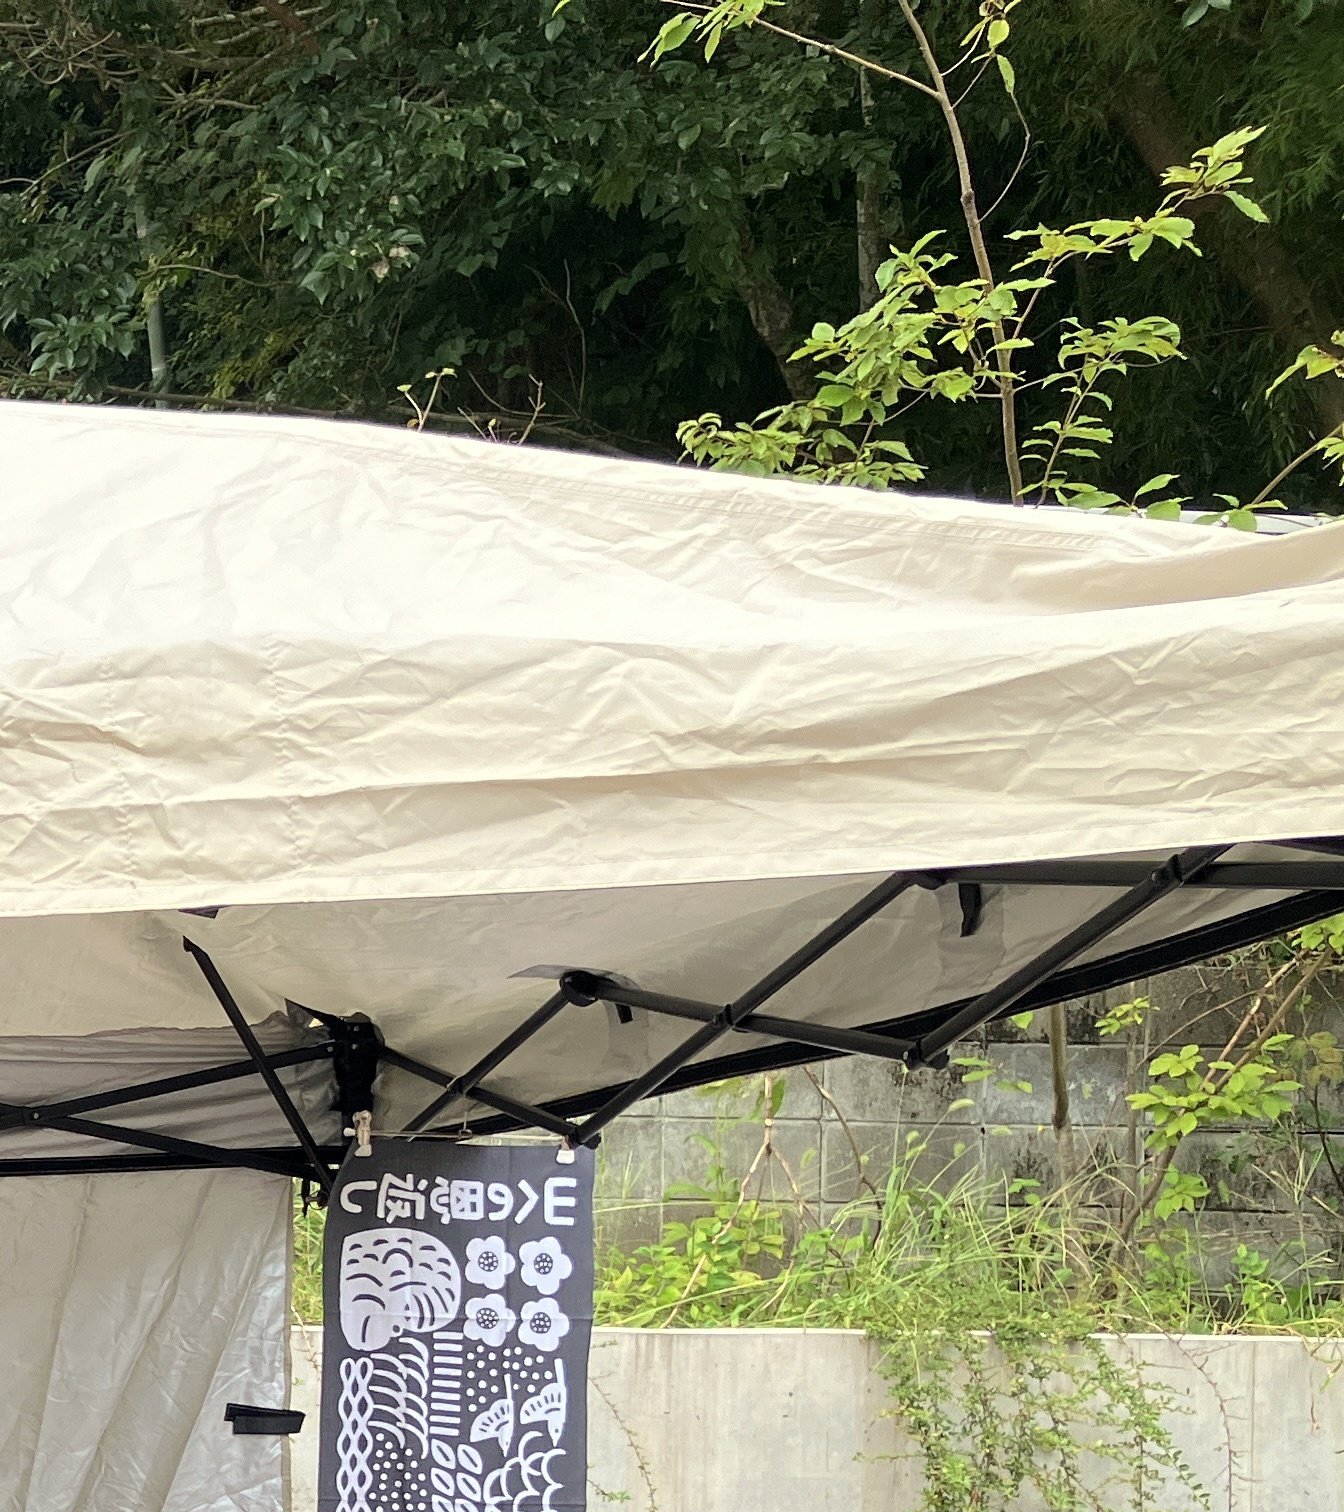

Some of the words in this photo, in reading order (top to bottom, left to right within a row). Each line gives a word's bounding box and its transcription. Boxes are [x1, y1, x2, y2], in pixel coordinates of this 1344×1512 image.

[340, 1172, 577, 1226] 山への恩返し
